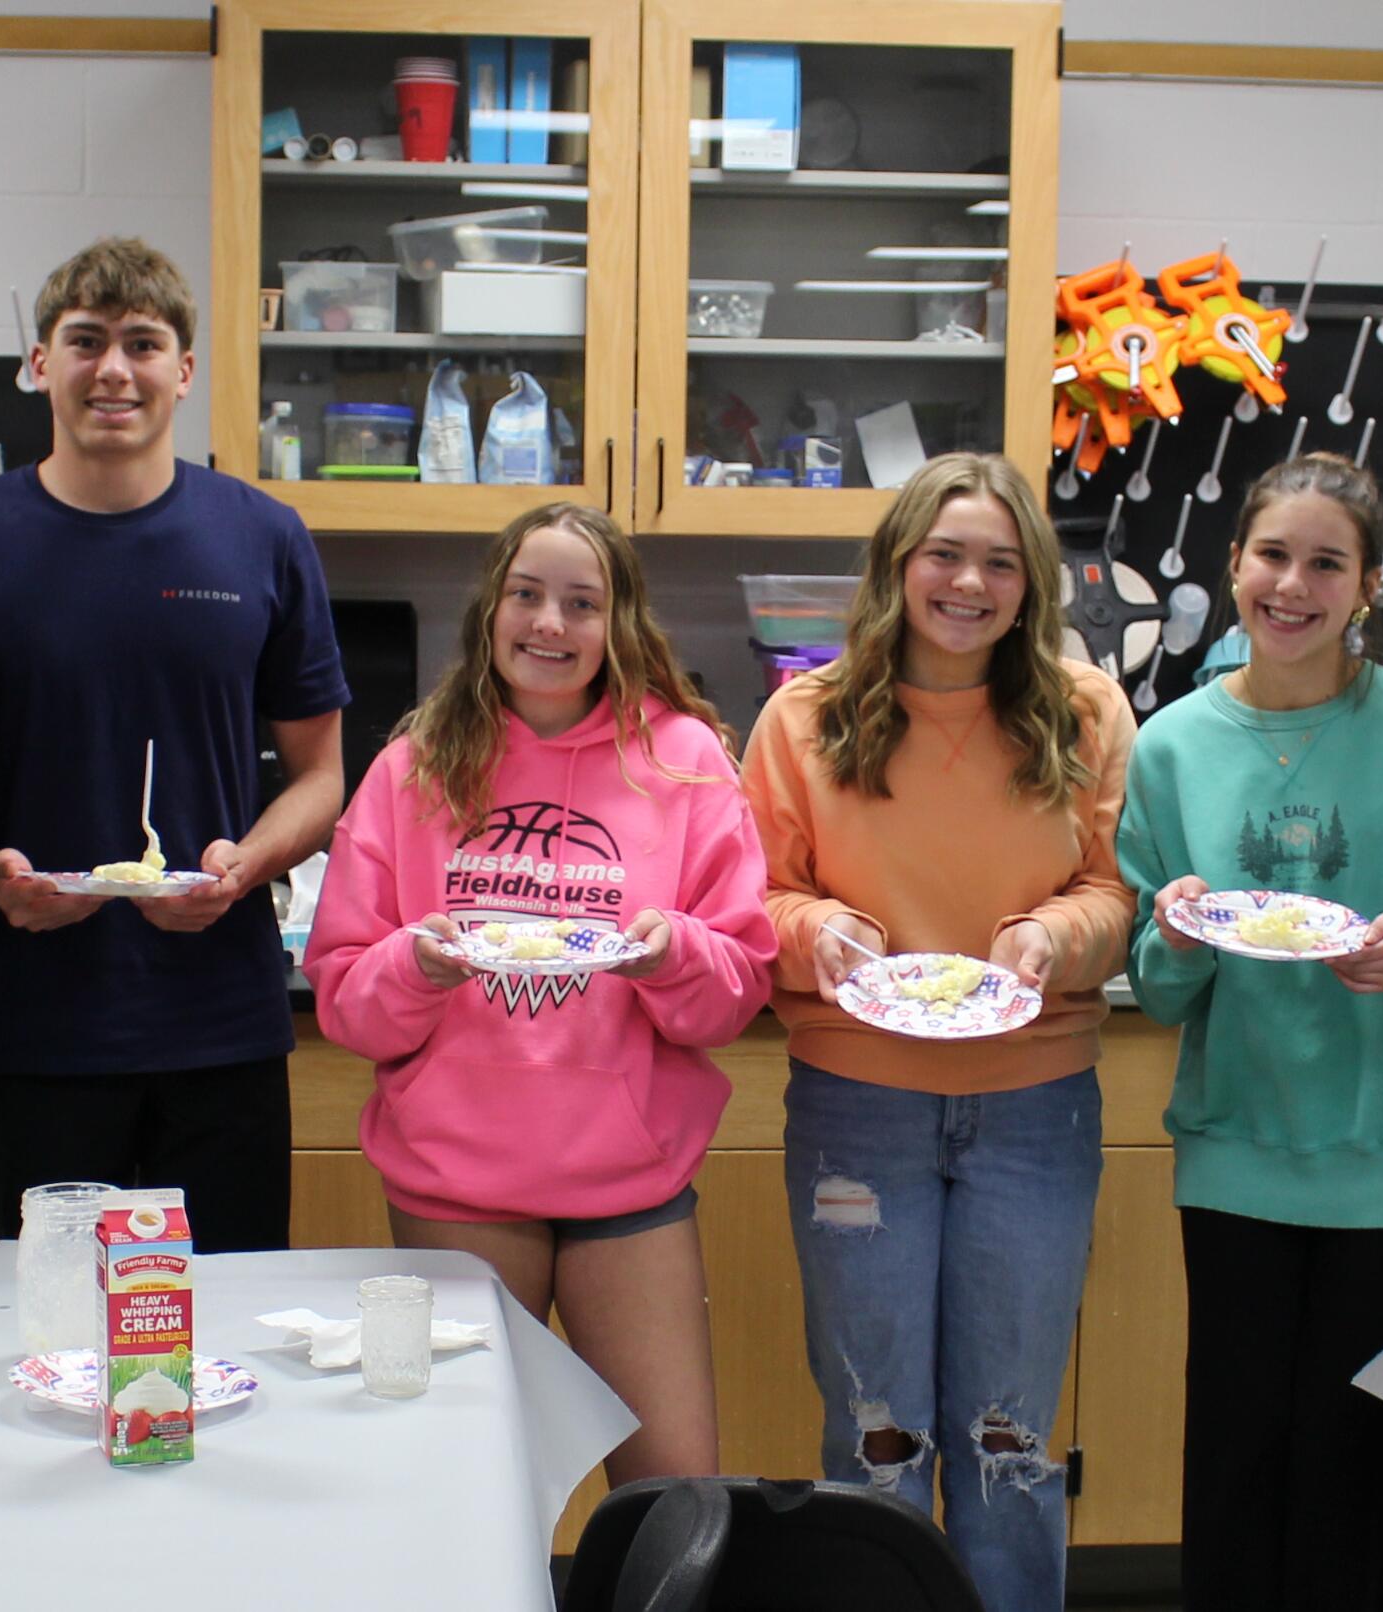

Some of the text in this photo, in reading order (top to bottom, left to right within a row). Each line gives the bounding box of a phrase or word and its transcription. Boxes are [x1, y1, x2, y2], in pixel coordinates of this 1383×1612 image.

[178, 590, 241, 603] FREEDOM
[1283, 804, 1320, 820] EAGLE
[446, 872, 623, 905] Fieldhouse
[474, 895, 587, 914] Wisconsin Dlls
[117, 1257, 155, 1272] Friendly
[156, 1256, 186, 1268] Farms
[130, 1294, 170, 1307] HEAVY
[120, 1305, 183, 1318] WHIPPING
[120, 1316, 182, 1332] CREAM
